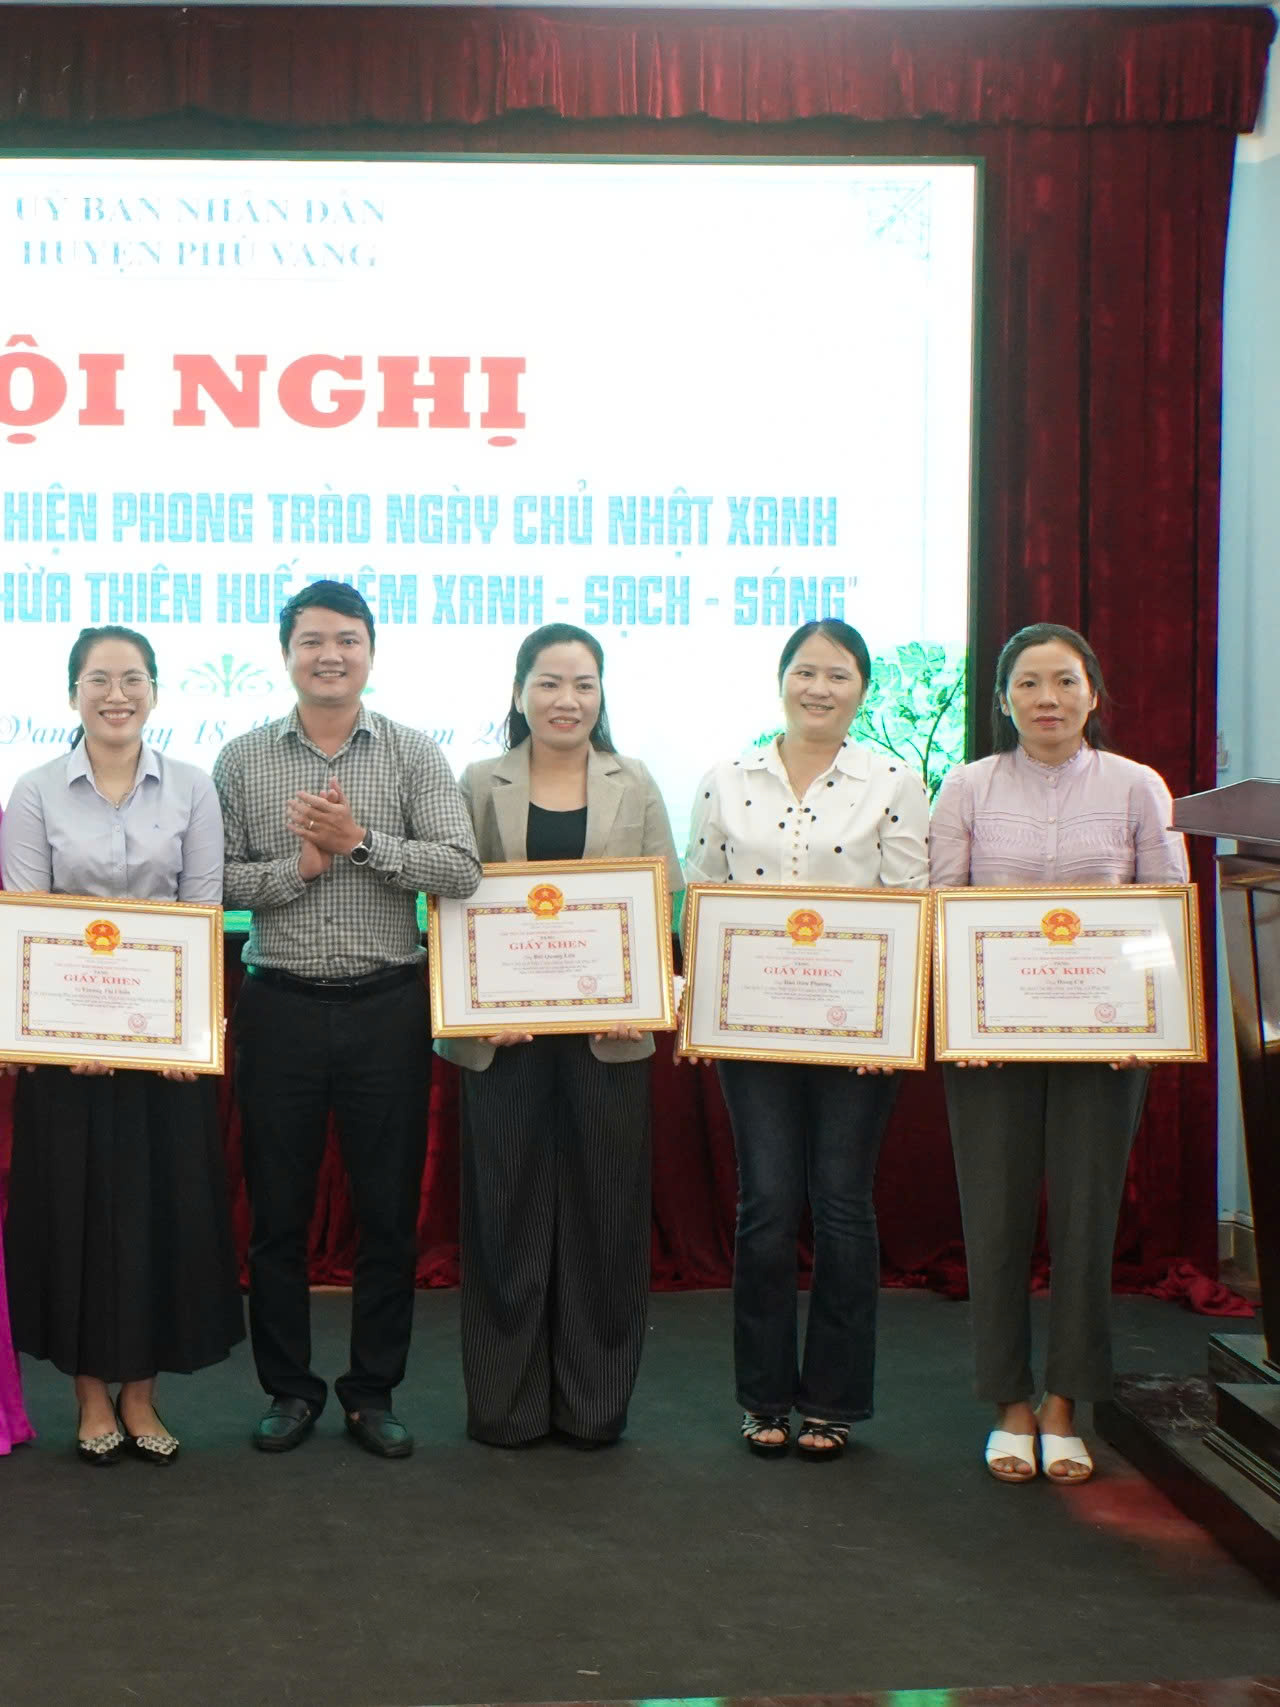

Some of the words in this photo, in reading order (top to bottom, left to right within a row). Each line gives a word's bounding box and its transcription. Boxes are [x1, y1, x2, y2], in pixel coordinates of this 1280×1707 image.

[82, 196, 161, 223] BAN
[269, 241, 376, 267] VANG
[172, 353, 526, 447] NGHỊ
[4, 482, 96, 555] HIỆN
[112, 491, 253, 543] PHONG
[268, 484, 371, 544] TRÀO
[387, 485, 498, 545] NGÀY
[514, 480, 592, 545] CHỦ
[608, 486, 713, 557] NHẬT
[727, 496, 837, 546] XANH
[86, 564, 201, 624] THIÊN
[216, 558, 300, 624] HUẾ
[432, 573, 543, 627] XANH
[584, 575, 691, 638] SẠCH
[547, 939, 588, 950] KHEN
[101, 976, 143, 987] KHEN
[802, 966, 844, 977] KHEN
[1020, 963, 1058, 976] GIẤY
[1062, 966, 1107, 976] KHEN
